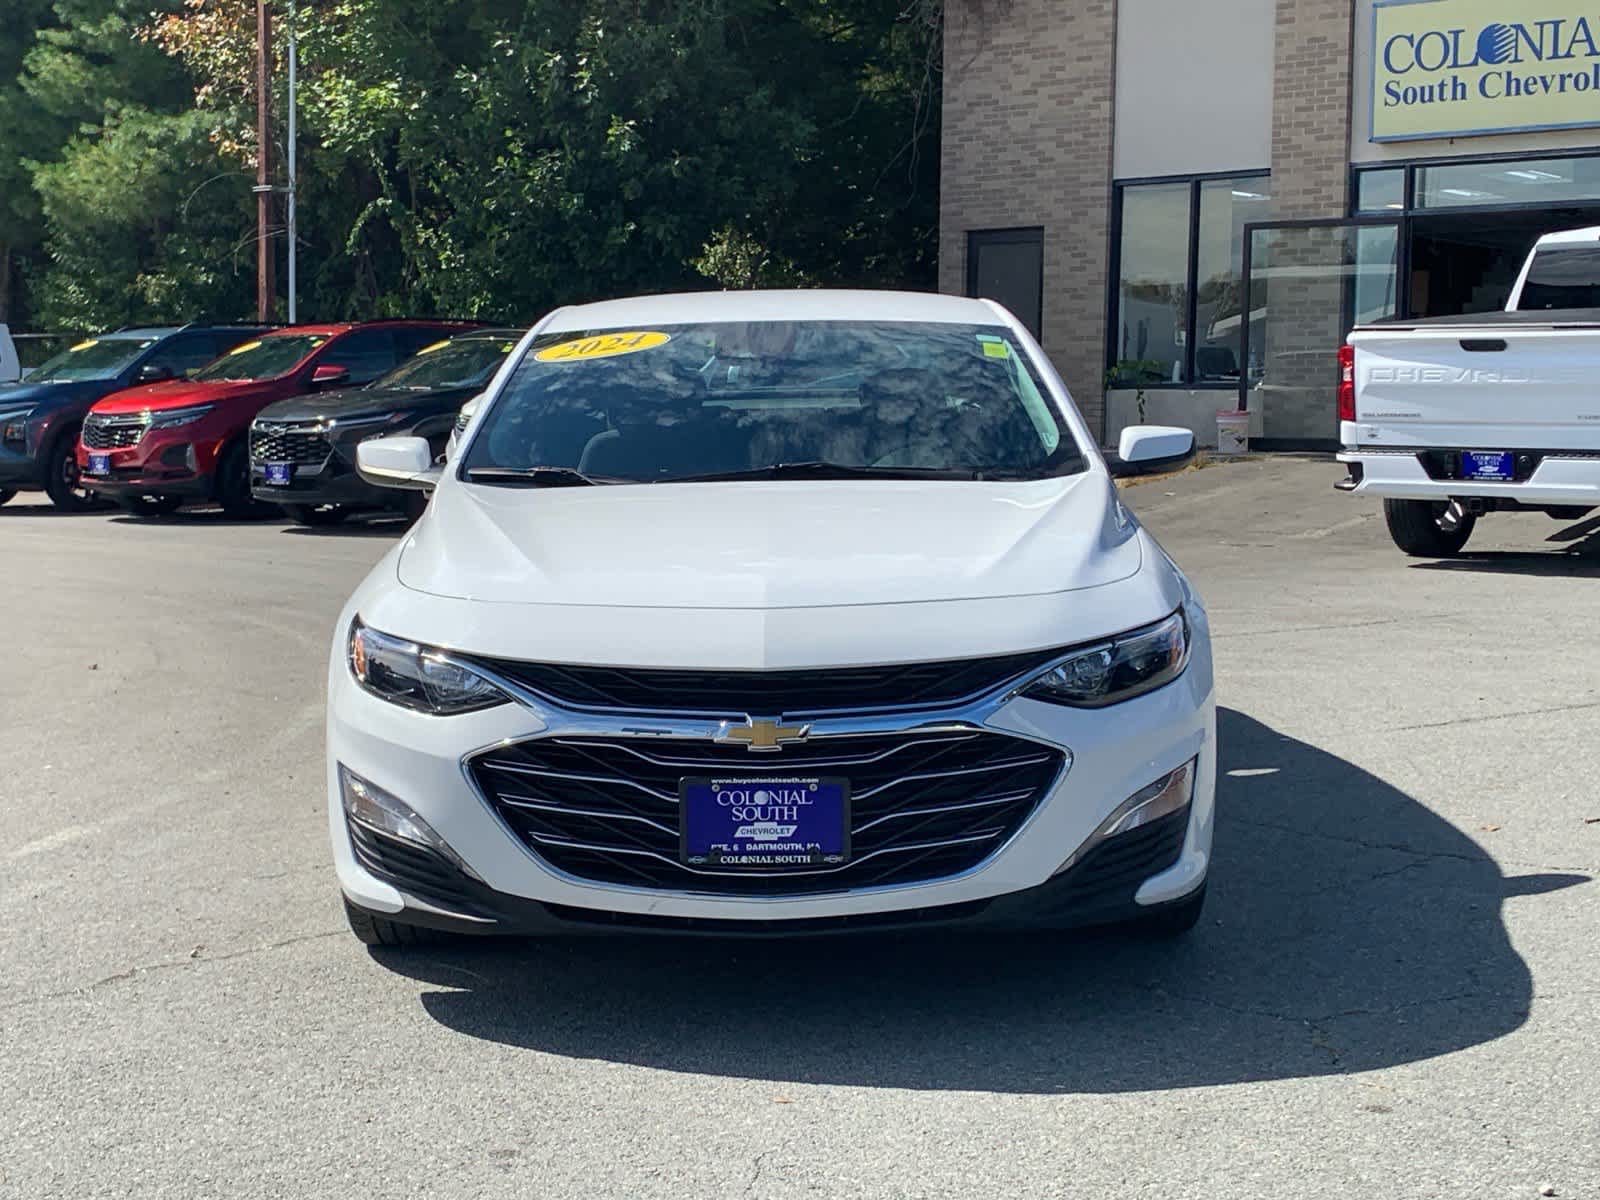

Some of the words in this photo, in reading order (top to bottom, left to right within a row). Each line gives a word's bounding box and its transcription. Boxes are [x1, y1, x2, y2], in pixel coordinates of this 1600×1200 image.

[1384, 75, 1467, 107] South
[1479, 63, 1600, 99] Chevrol
[552, 333, 647, 359] 2024
[717, 790, 813, 806] COLONIAL
[732, 806, 798, 821] SOUTH
[740, 827, 791, 835] CHEVROLET
[746, 843, 805, 852] DARTMOUTH,
[720, 855, 774, 863] COLONIAL
[775, 855, 811, 863] SOUTH
